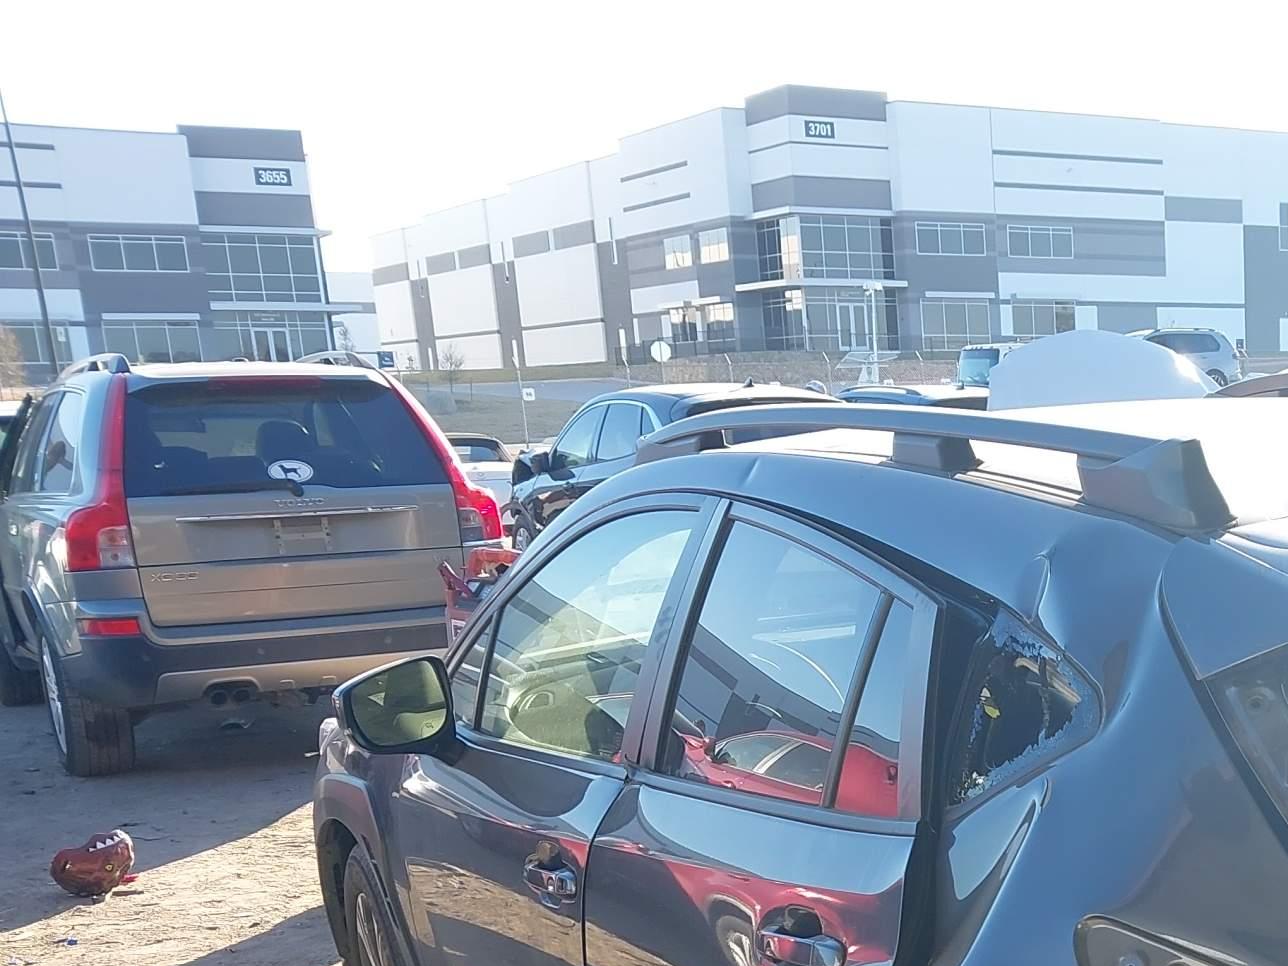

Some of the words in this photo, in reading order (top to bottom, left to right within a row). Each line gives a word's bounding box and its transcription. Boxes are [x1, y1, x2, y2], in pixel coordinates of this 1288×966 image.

[808, 122, 832, 137] 3701
[258, 170, 288, 184] 3655
[273, 497, 325, 508] VOLVO
